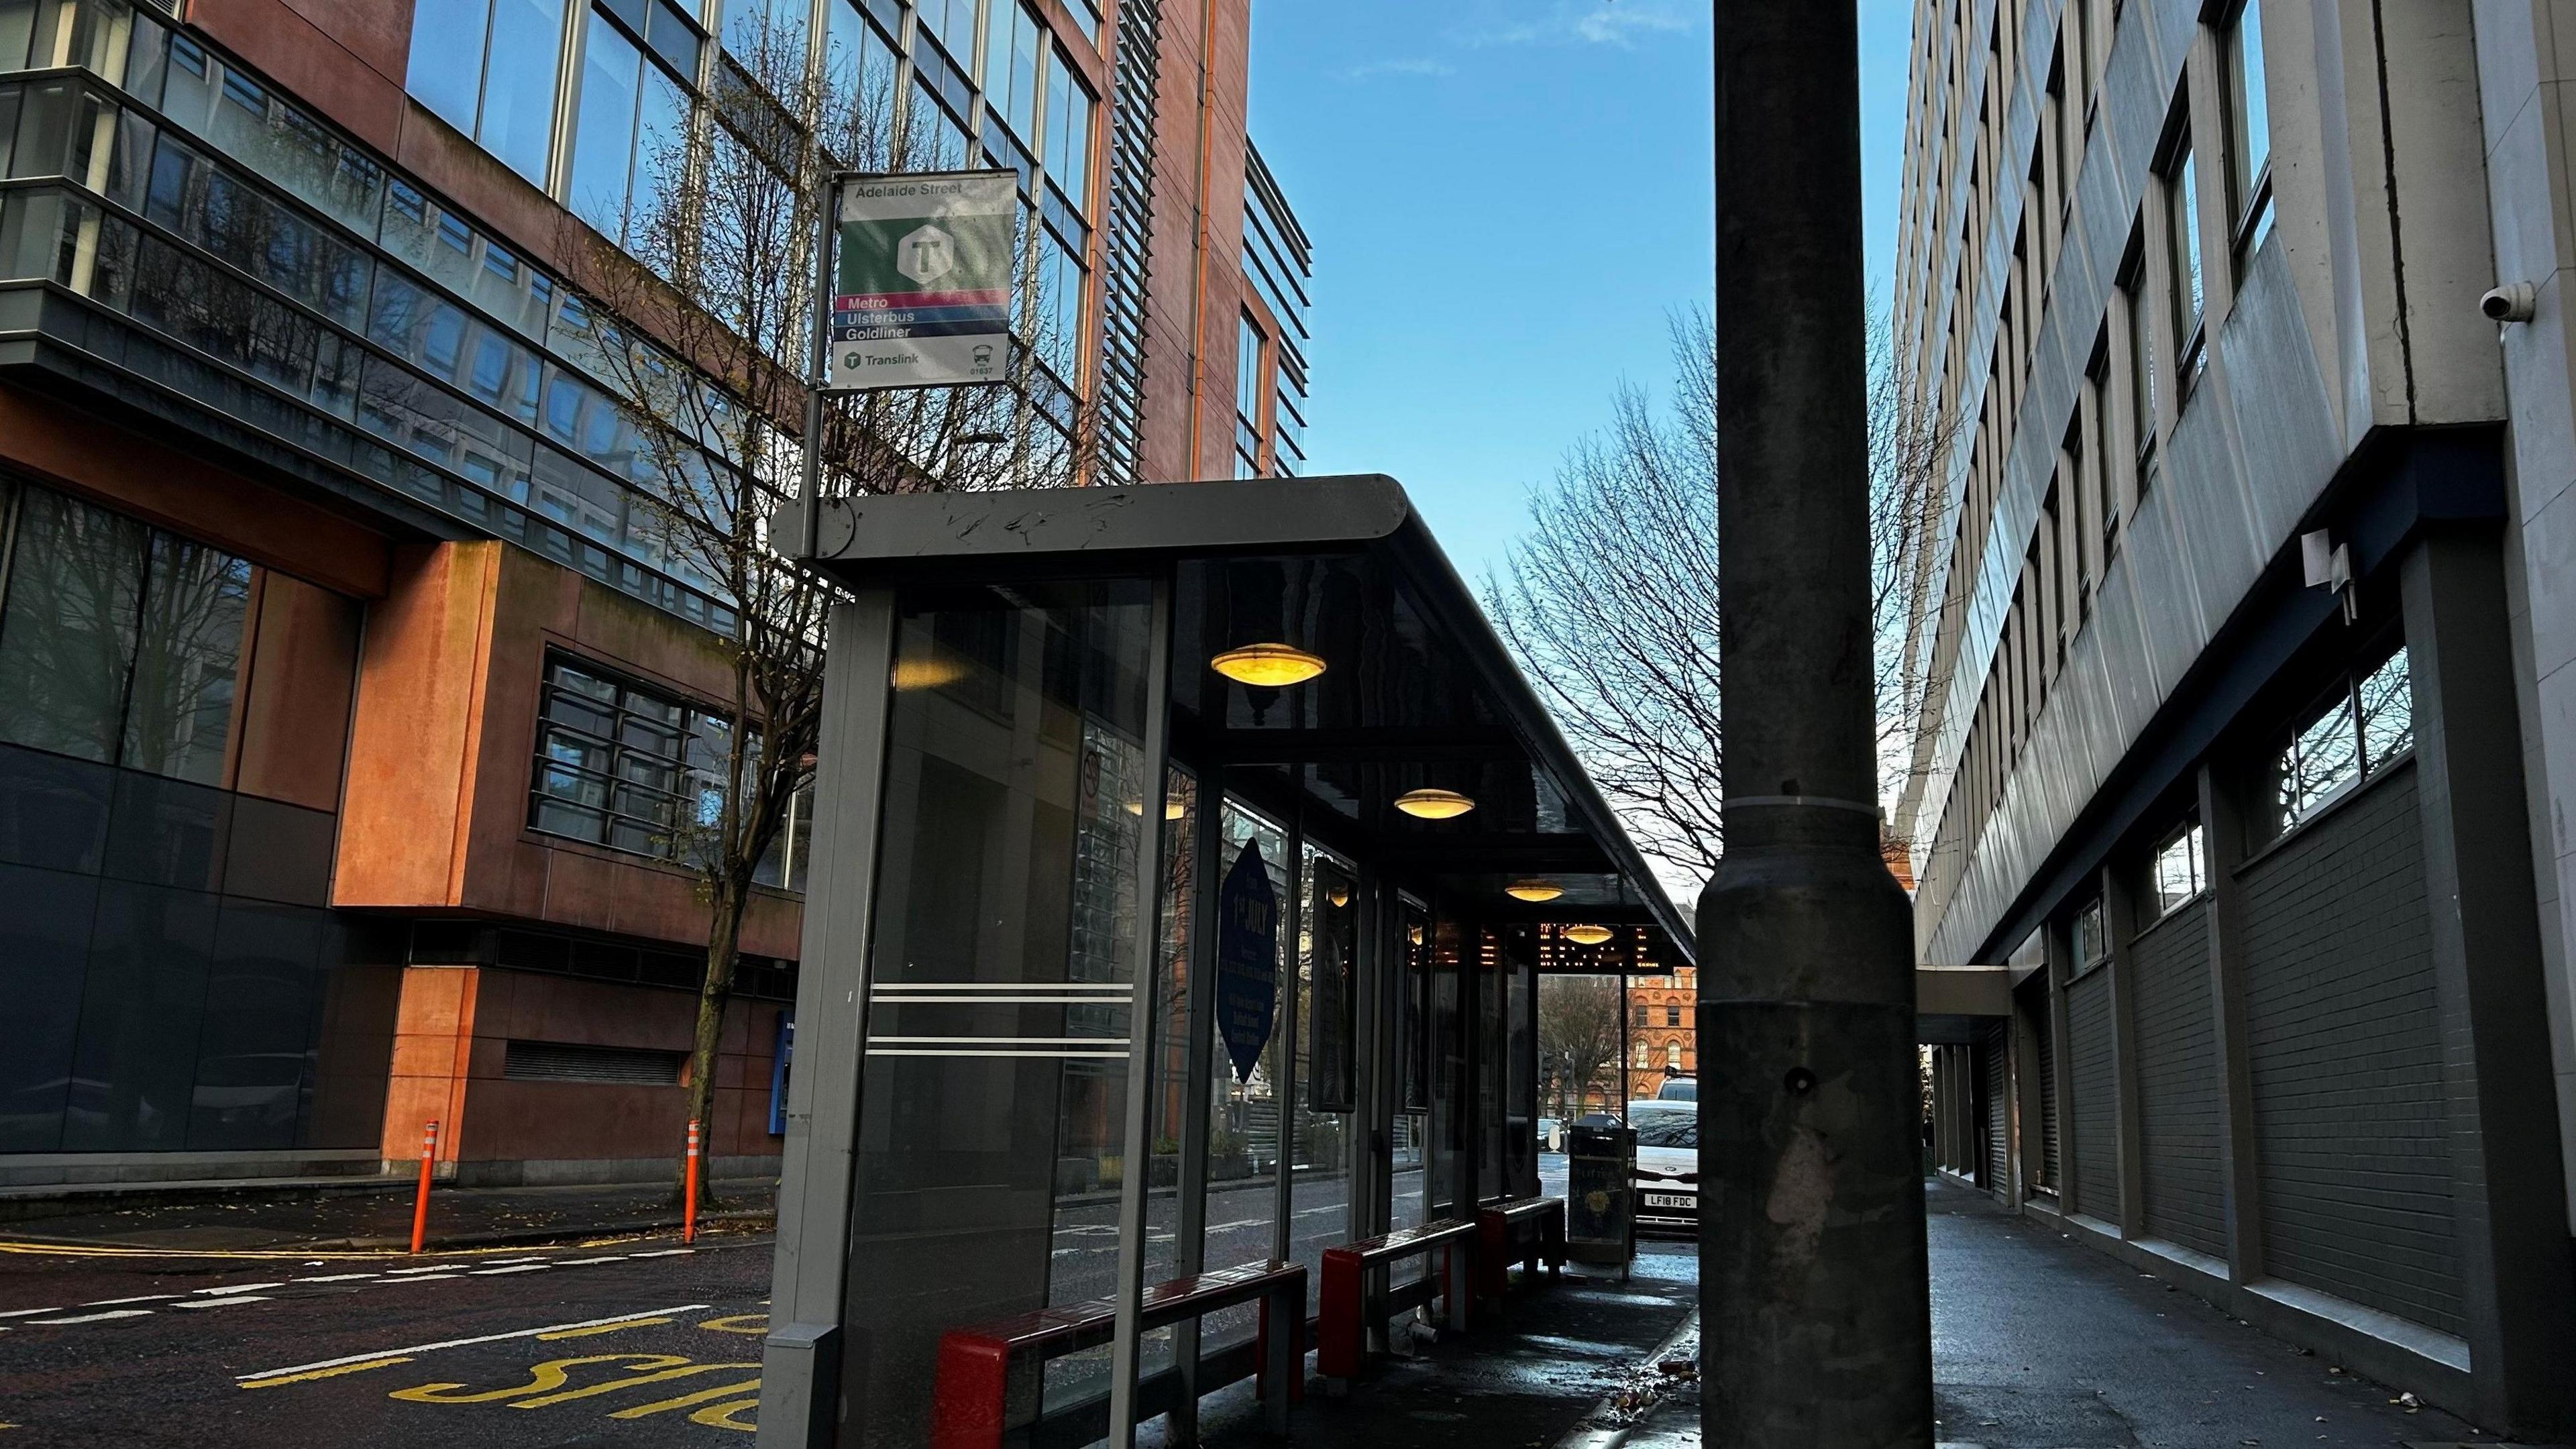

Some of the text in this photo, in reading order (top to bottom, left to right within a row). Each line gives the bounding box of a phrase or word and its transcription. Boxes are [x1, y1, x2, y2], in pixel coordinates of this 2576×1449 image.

[855, 182, 962, 199] Adelaide Street
[848, 298, 888, 309] Metro
[847, 311, 915, 325] Ulsterbus
[846, 327, 911, 340] Goldliner
[865, 353, 918, 366] Translink
[1245, 898, 1269, 936] JULY
[1651, 1195, 1691, 1207] LF18 FDC
